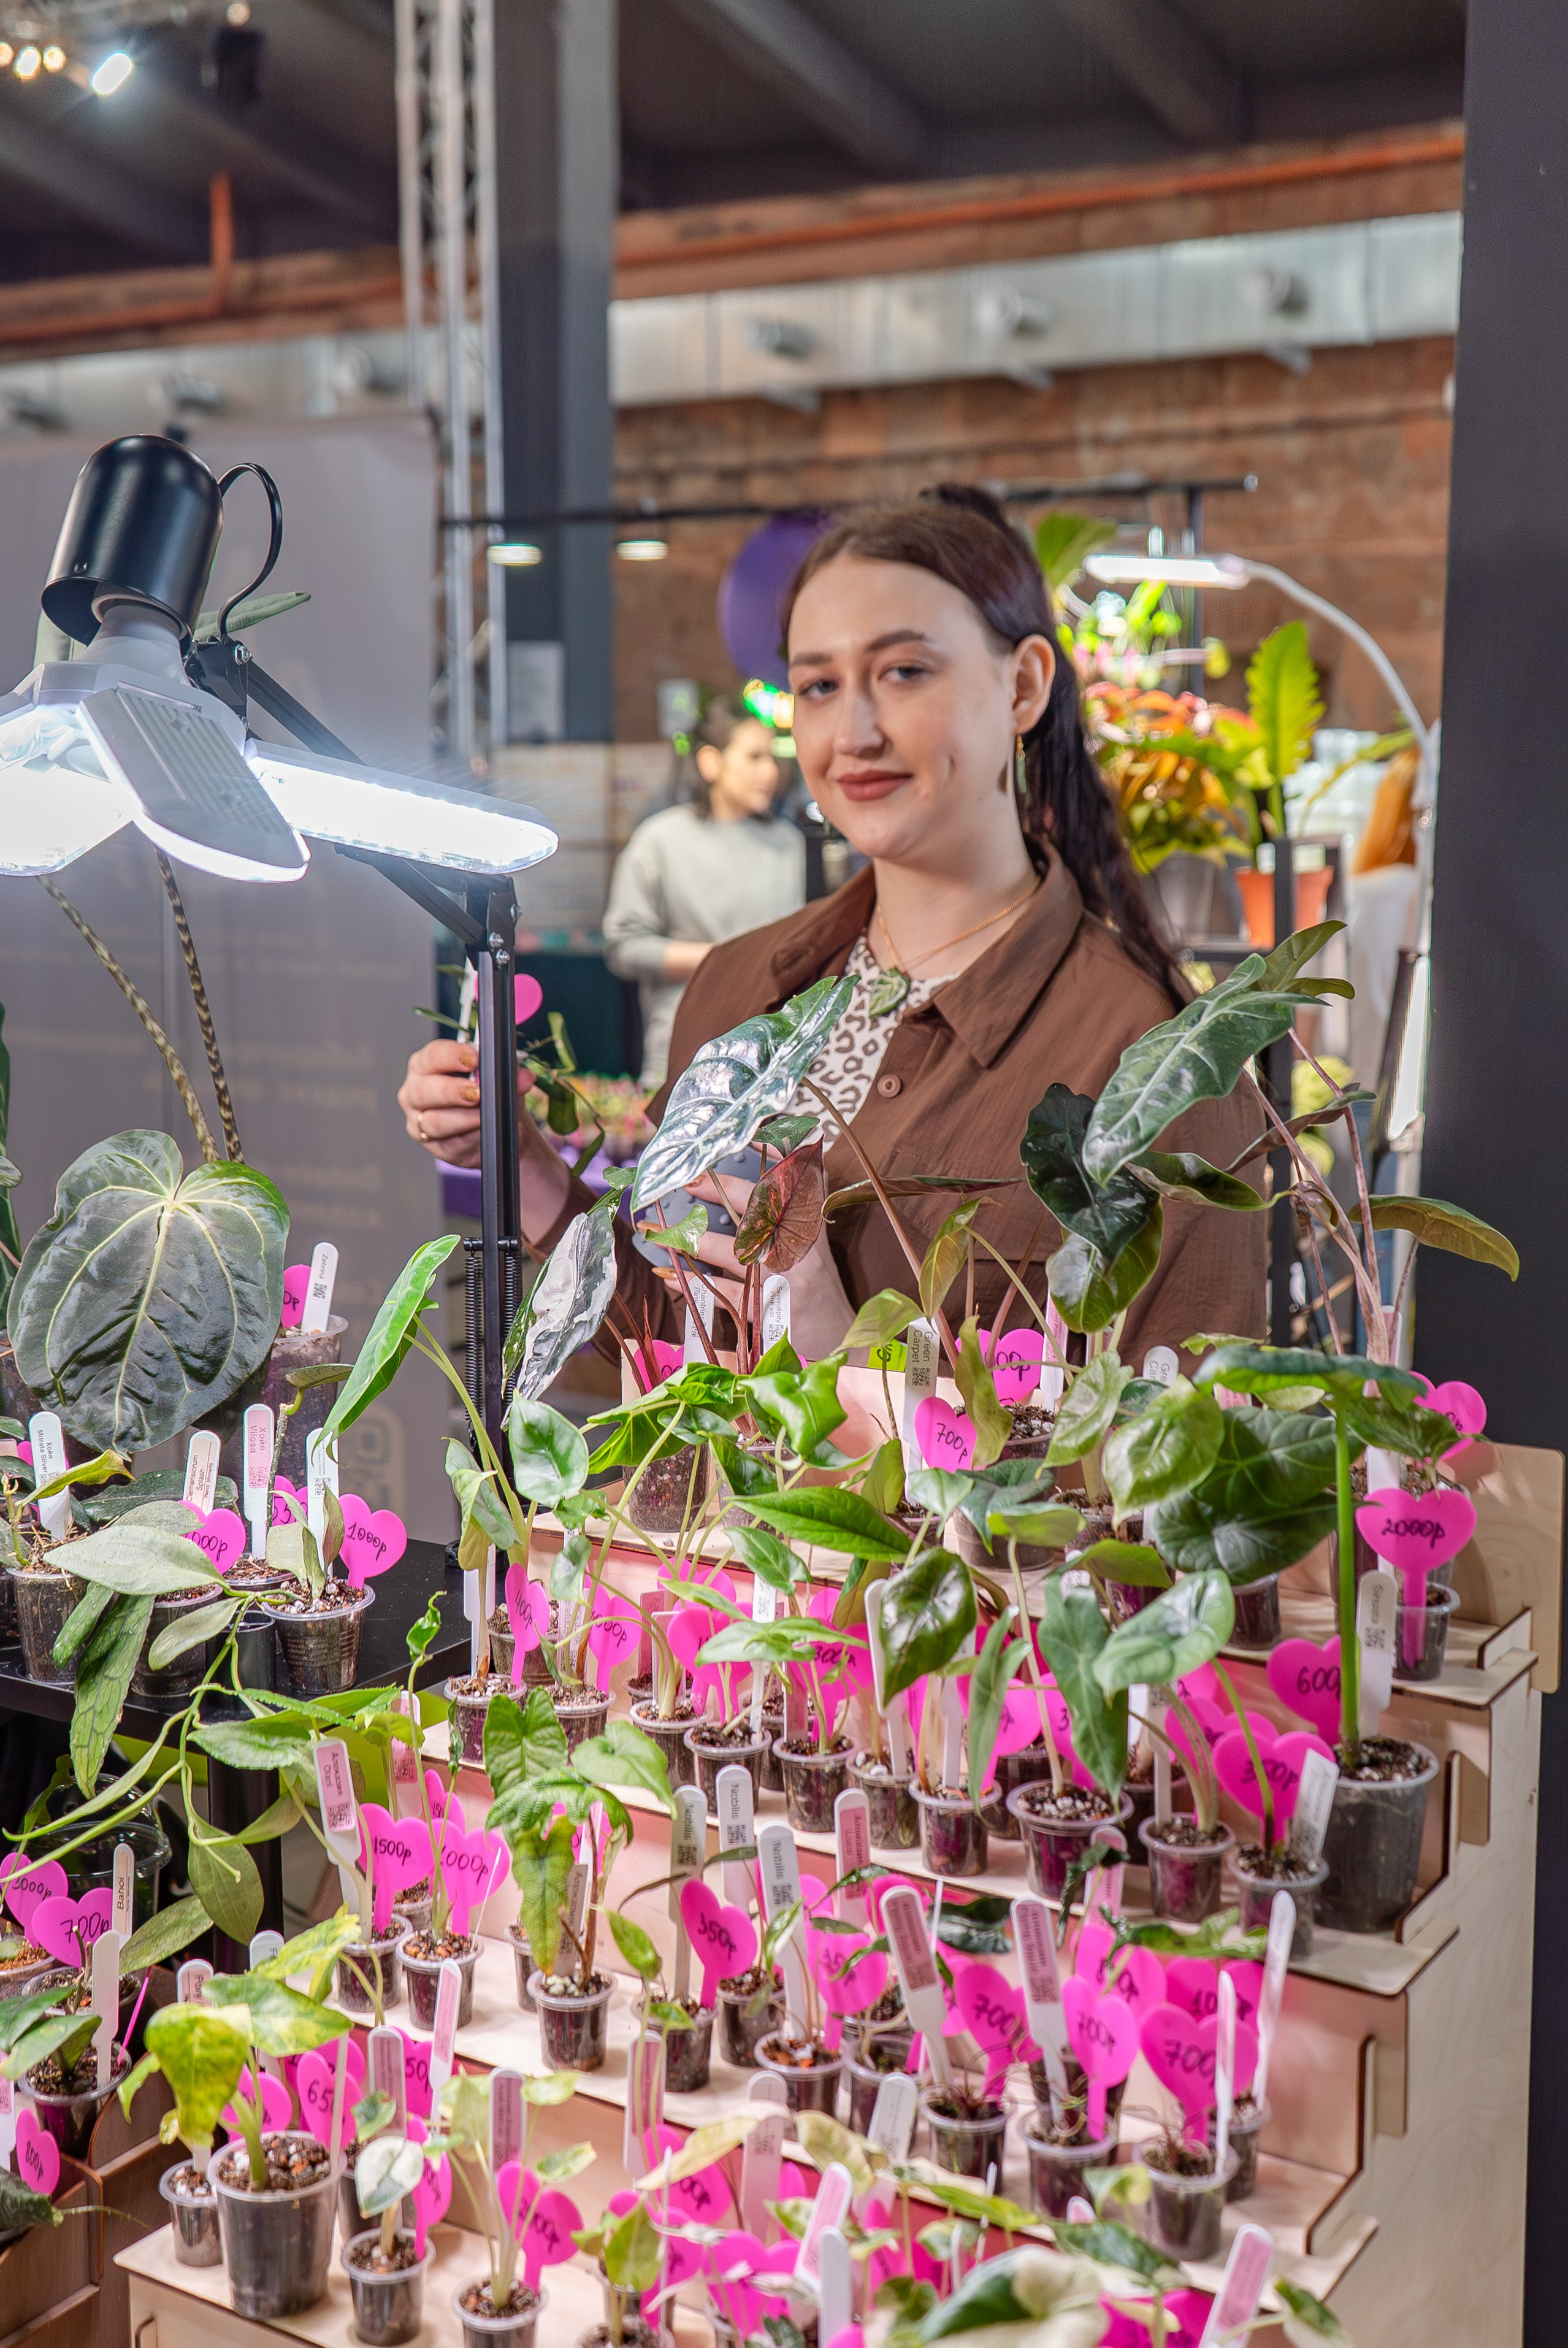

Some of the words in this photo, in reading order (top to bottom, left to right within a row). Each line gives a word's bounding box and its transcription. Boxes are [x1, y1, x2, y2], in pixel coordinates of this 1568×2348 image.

[319, 1253, 329, 1280] Zebrina
[912, 1330, 923, 1363] Carpet
[923, 1332, 933, 1362] Green
[936, 1422, 968, 1464] 700р
[196, 1468, 206, 1492] Splash
[346, 1522, 388, 1562] 1000р
[1381, 1517, 1446, 1549] 2000р
[515, 1589, 533, 1630] 400р
[1296, 1665, 1340, 1702] 600
[373, 1836, 411, 1866] 1500р
[60, 1912, 109, 1944] 700р
[1164, 2038, 1217, 2089] 700
